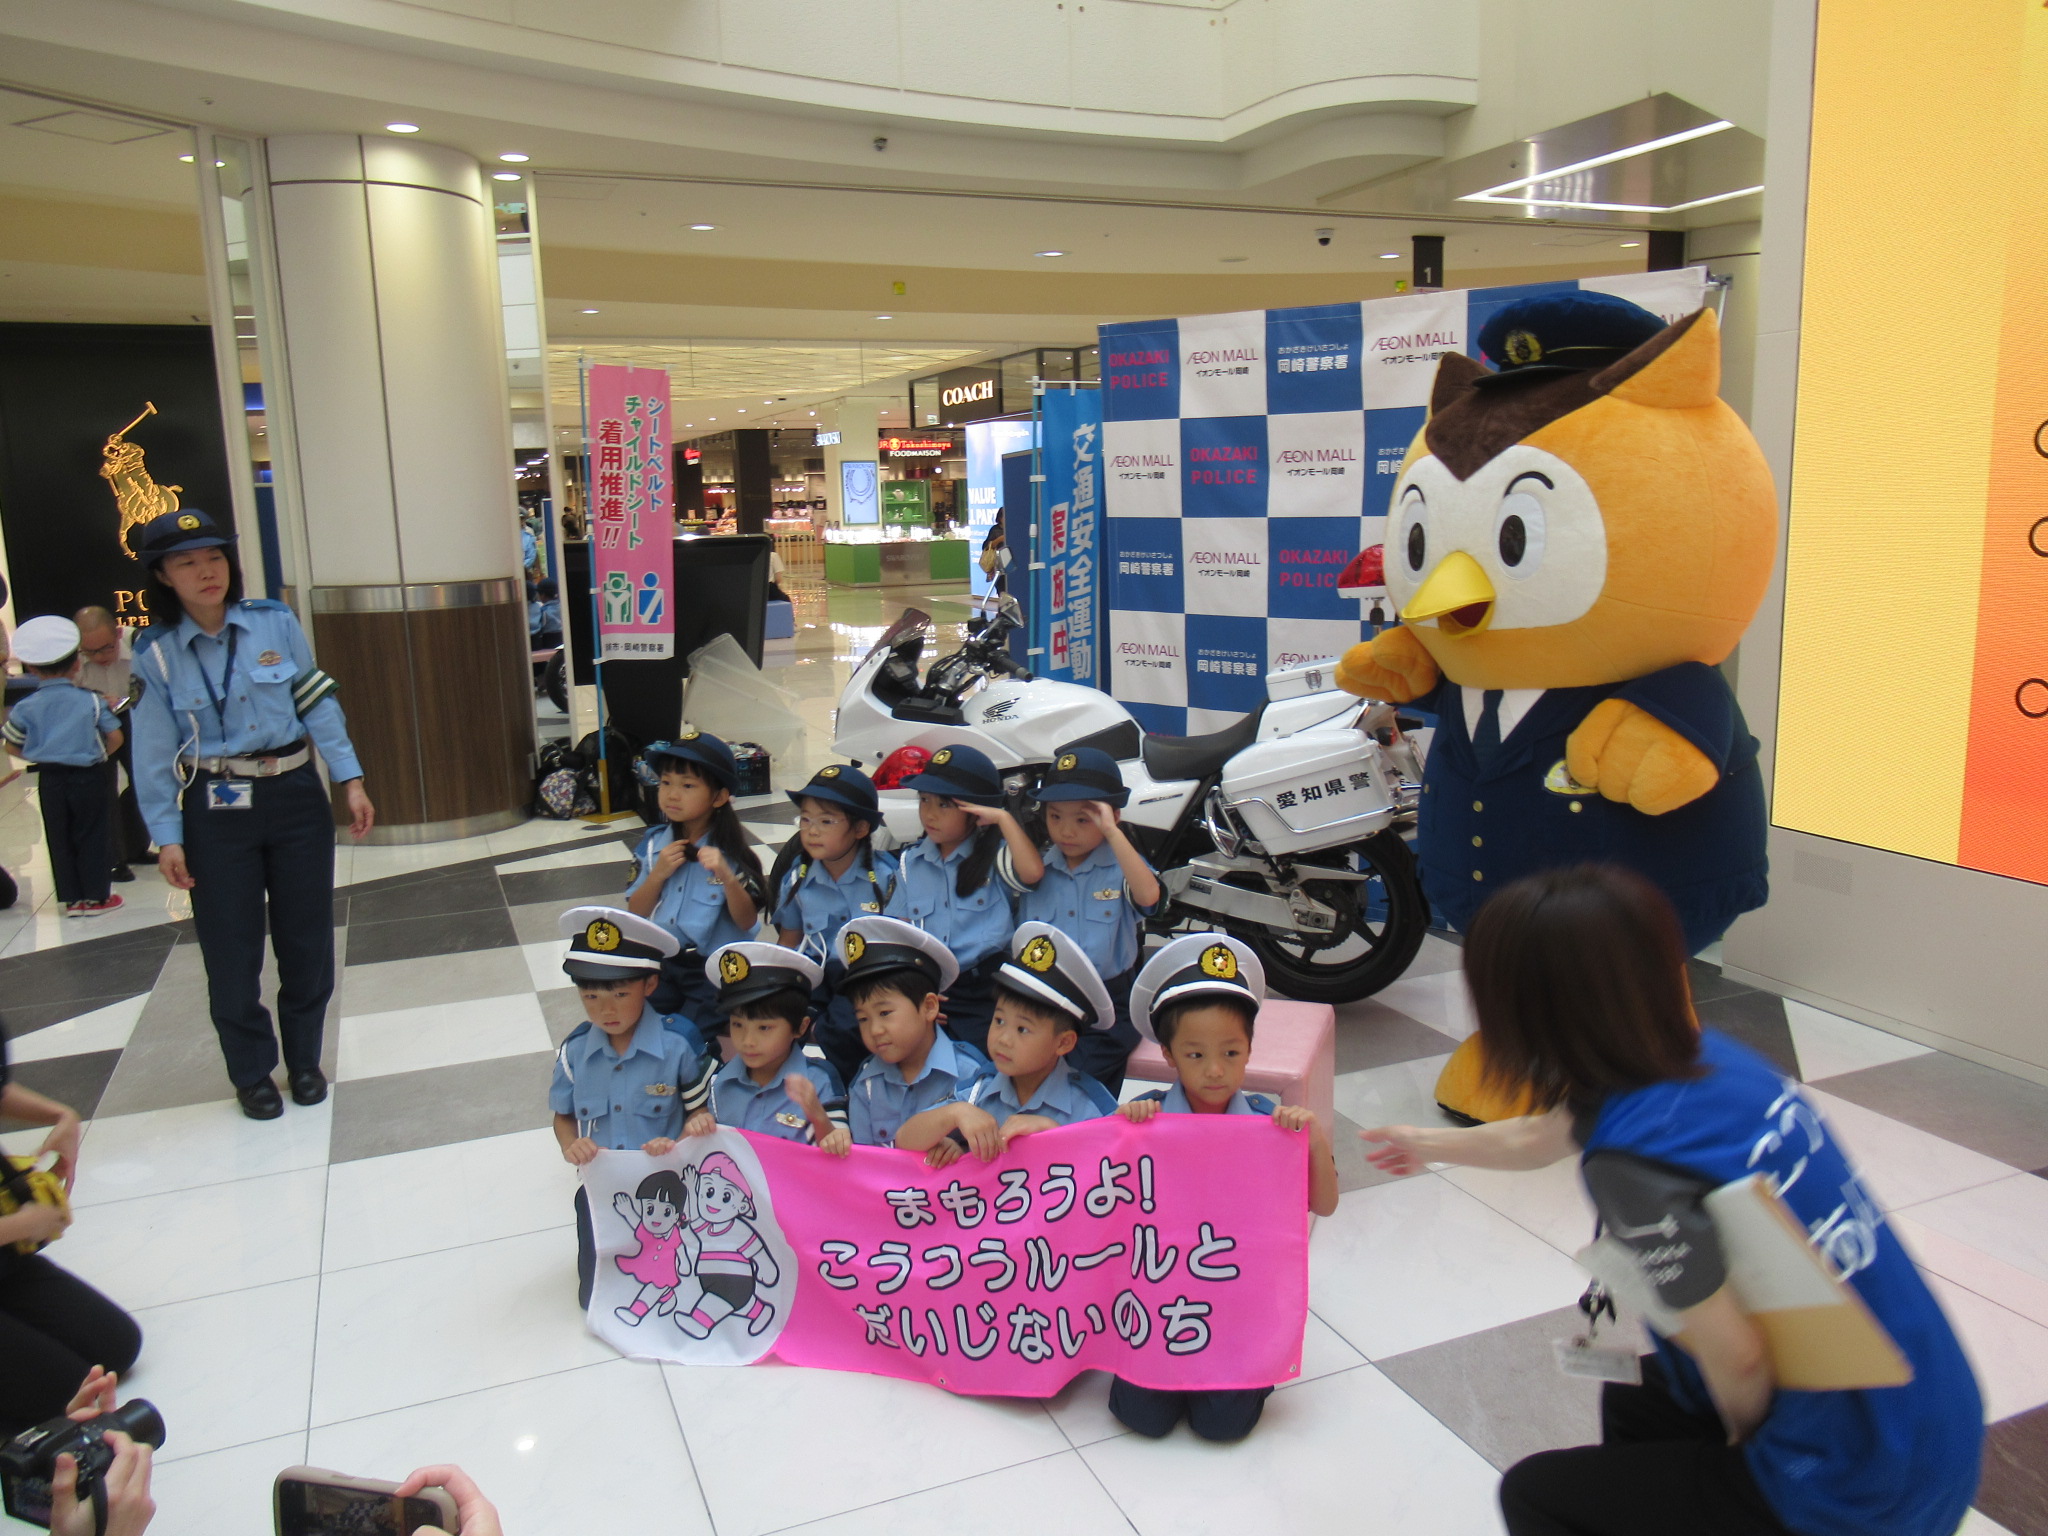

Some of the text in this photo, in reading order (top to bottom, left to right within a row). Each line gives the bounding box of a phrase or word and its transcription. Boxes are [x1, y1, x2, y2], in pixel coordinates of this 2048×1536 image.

[1424, 267, 1432, 284] 1
[1416, 331, 1458, 347] MALL
[1109, 350, 1169, 368] OKAZAKI
[1223, 348, 1259, 363] MALL
[1196, 366, 1249, 377] イオンモール岡崎
[1277, 355, 1349, 374] 岡崎警察署
[1110, 372, 1168, 389] POLICE
[943, 380, 994, 407] COACH
[900, 440, 952, 450] Takashimaya
[647, 397, 665, 511] シートベルト
[1143, 454, 1174, 467] MALL
[1190, 447, 1258, 462] OKAZAKI
[1317, 448, 1357, 462] MALL
[625, 396, 644, 550] チャイルドシート
[1119, 471, 1165, 480] イオンモール岡崎
[1191, 469, 1258, 485] POLICE
[1287, 467, 1345, 476] イオンモール岡崎
[1068, 423, 1097, 681] 交通安全運動
[1225, 552, 1261, 565] MALL
[1279, 550, 1348, 564] OKAZAKI
[1119, 561, 1174, 576] 岡崎警察署
[1198, 569, 1250, 578] イオンモール岡崎
[1280, 572, 1341, 588] POLIC
[1148, 644, 1180, 658] MALL
[1125, 659, 1172, 669] イオンモール岡崎
[1197, 659, 1258, 676] 岡崎警察署
[982, 714, 1020, 724] HONDA
[1276, 772, 1372, 810] 愛知県警
[885, 1154, 1156, 1229] まもろうよ!
[818, 1221, 1241, 1293] こうつうルールと
[854, 1288, 1213, 1364] だいじないのち
